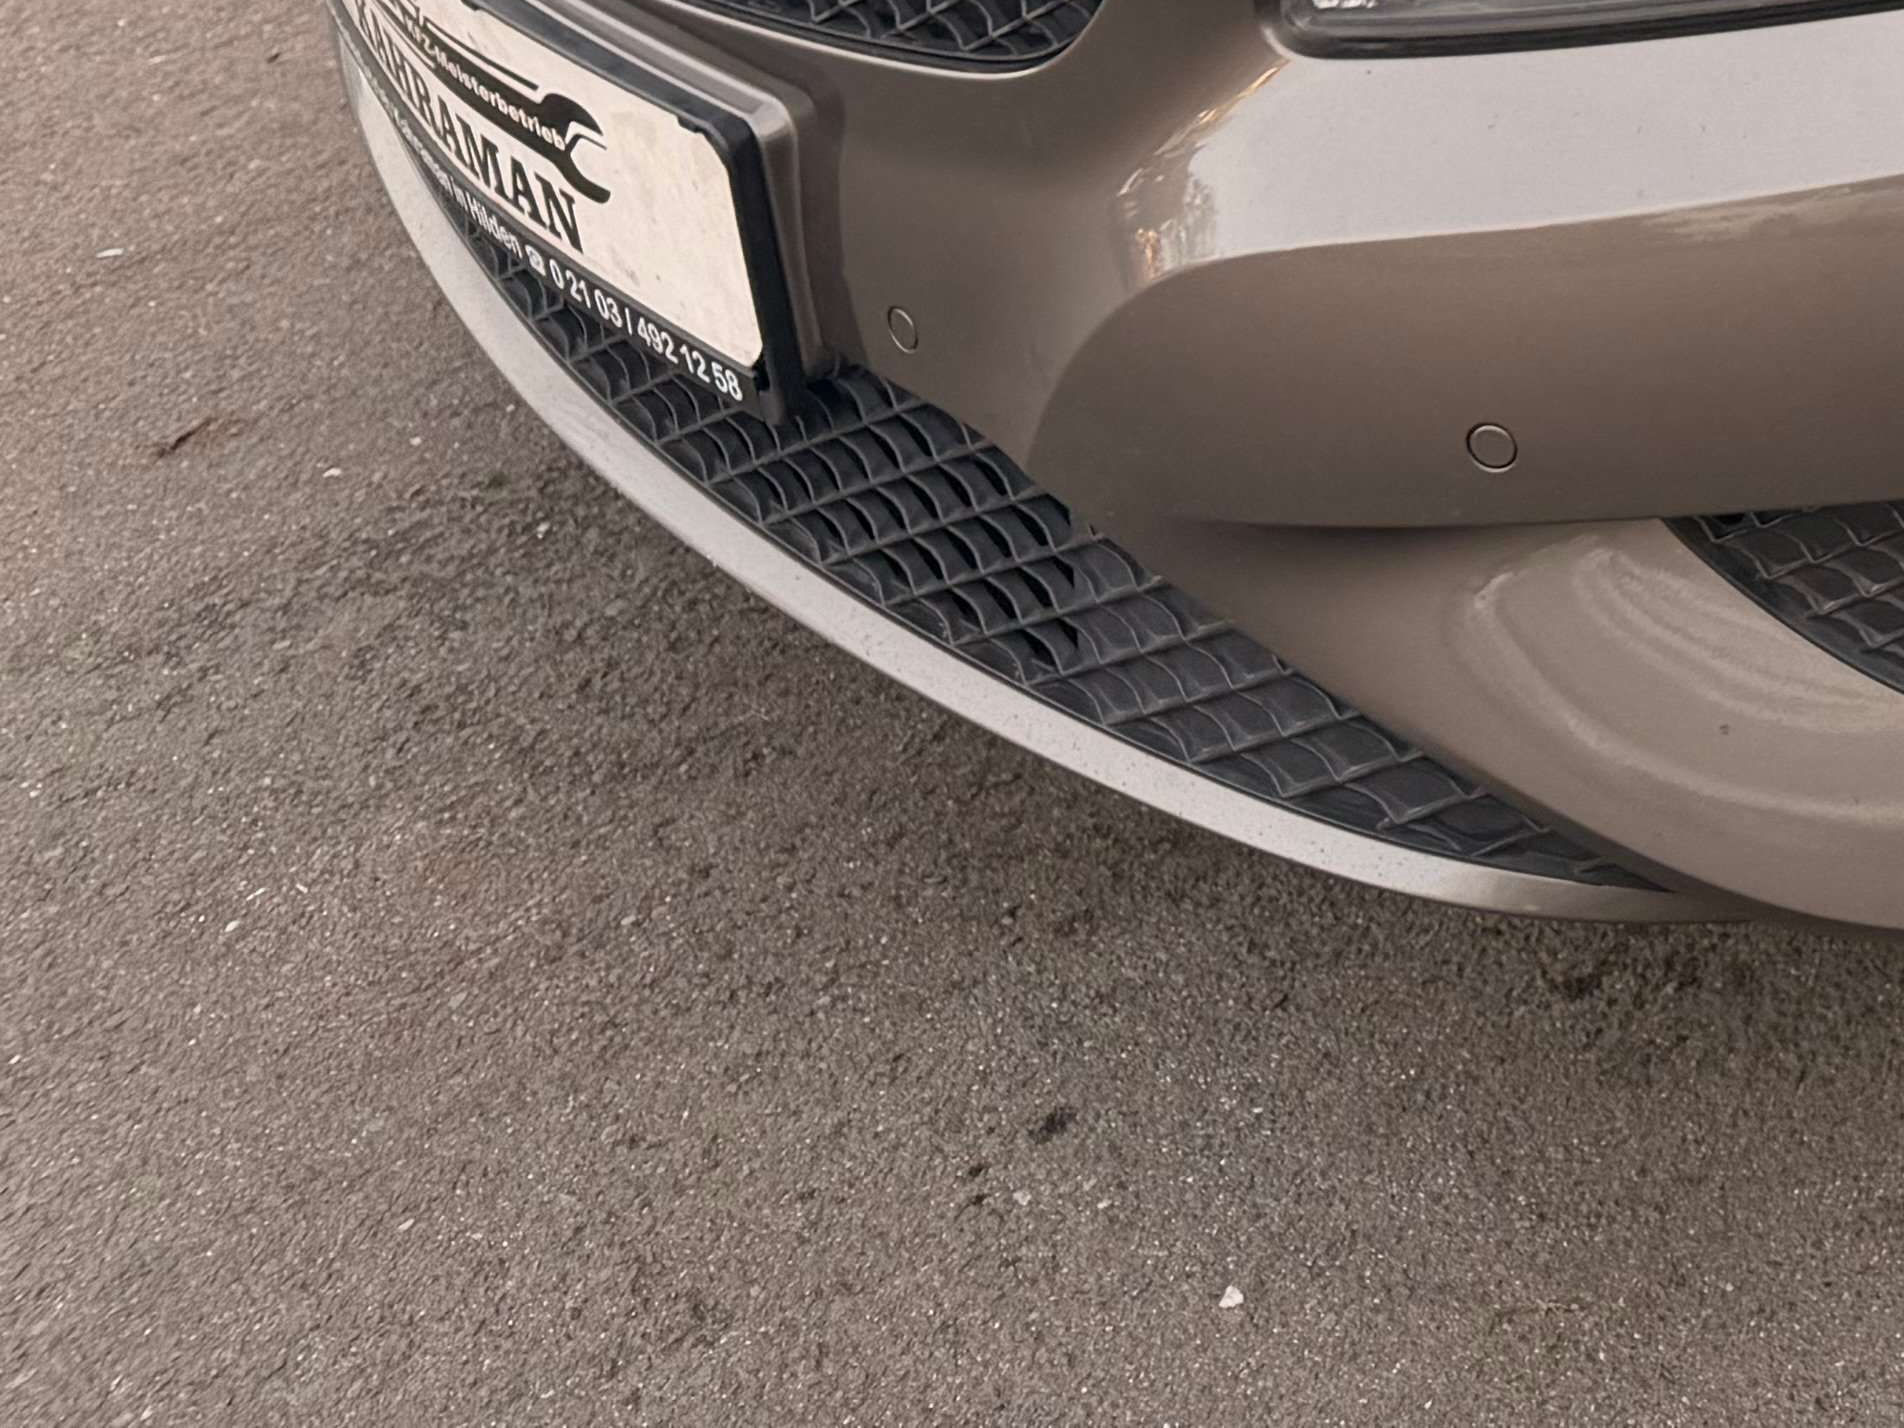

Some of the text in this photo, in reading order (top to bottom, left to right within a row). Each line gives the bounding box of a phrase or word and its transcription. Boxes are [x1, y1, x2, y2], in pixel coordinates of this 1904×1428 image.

[465, 190, 523, 259] Hilden
[549, 258, 564, 290] 0
[593, 288, 623, 328] 03
[711, 360, 743, 402] 58
